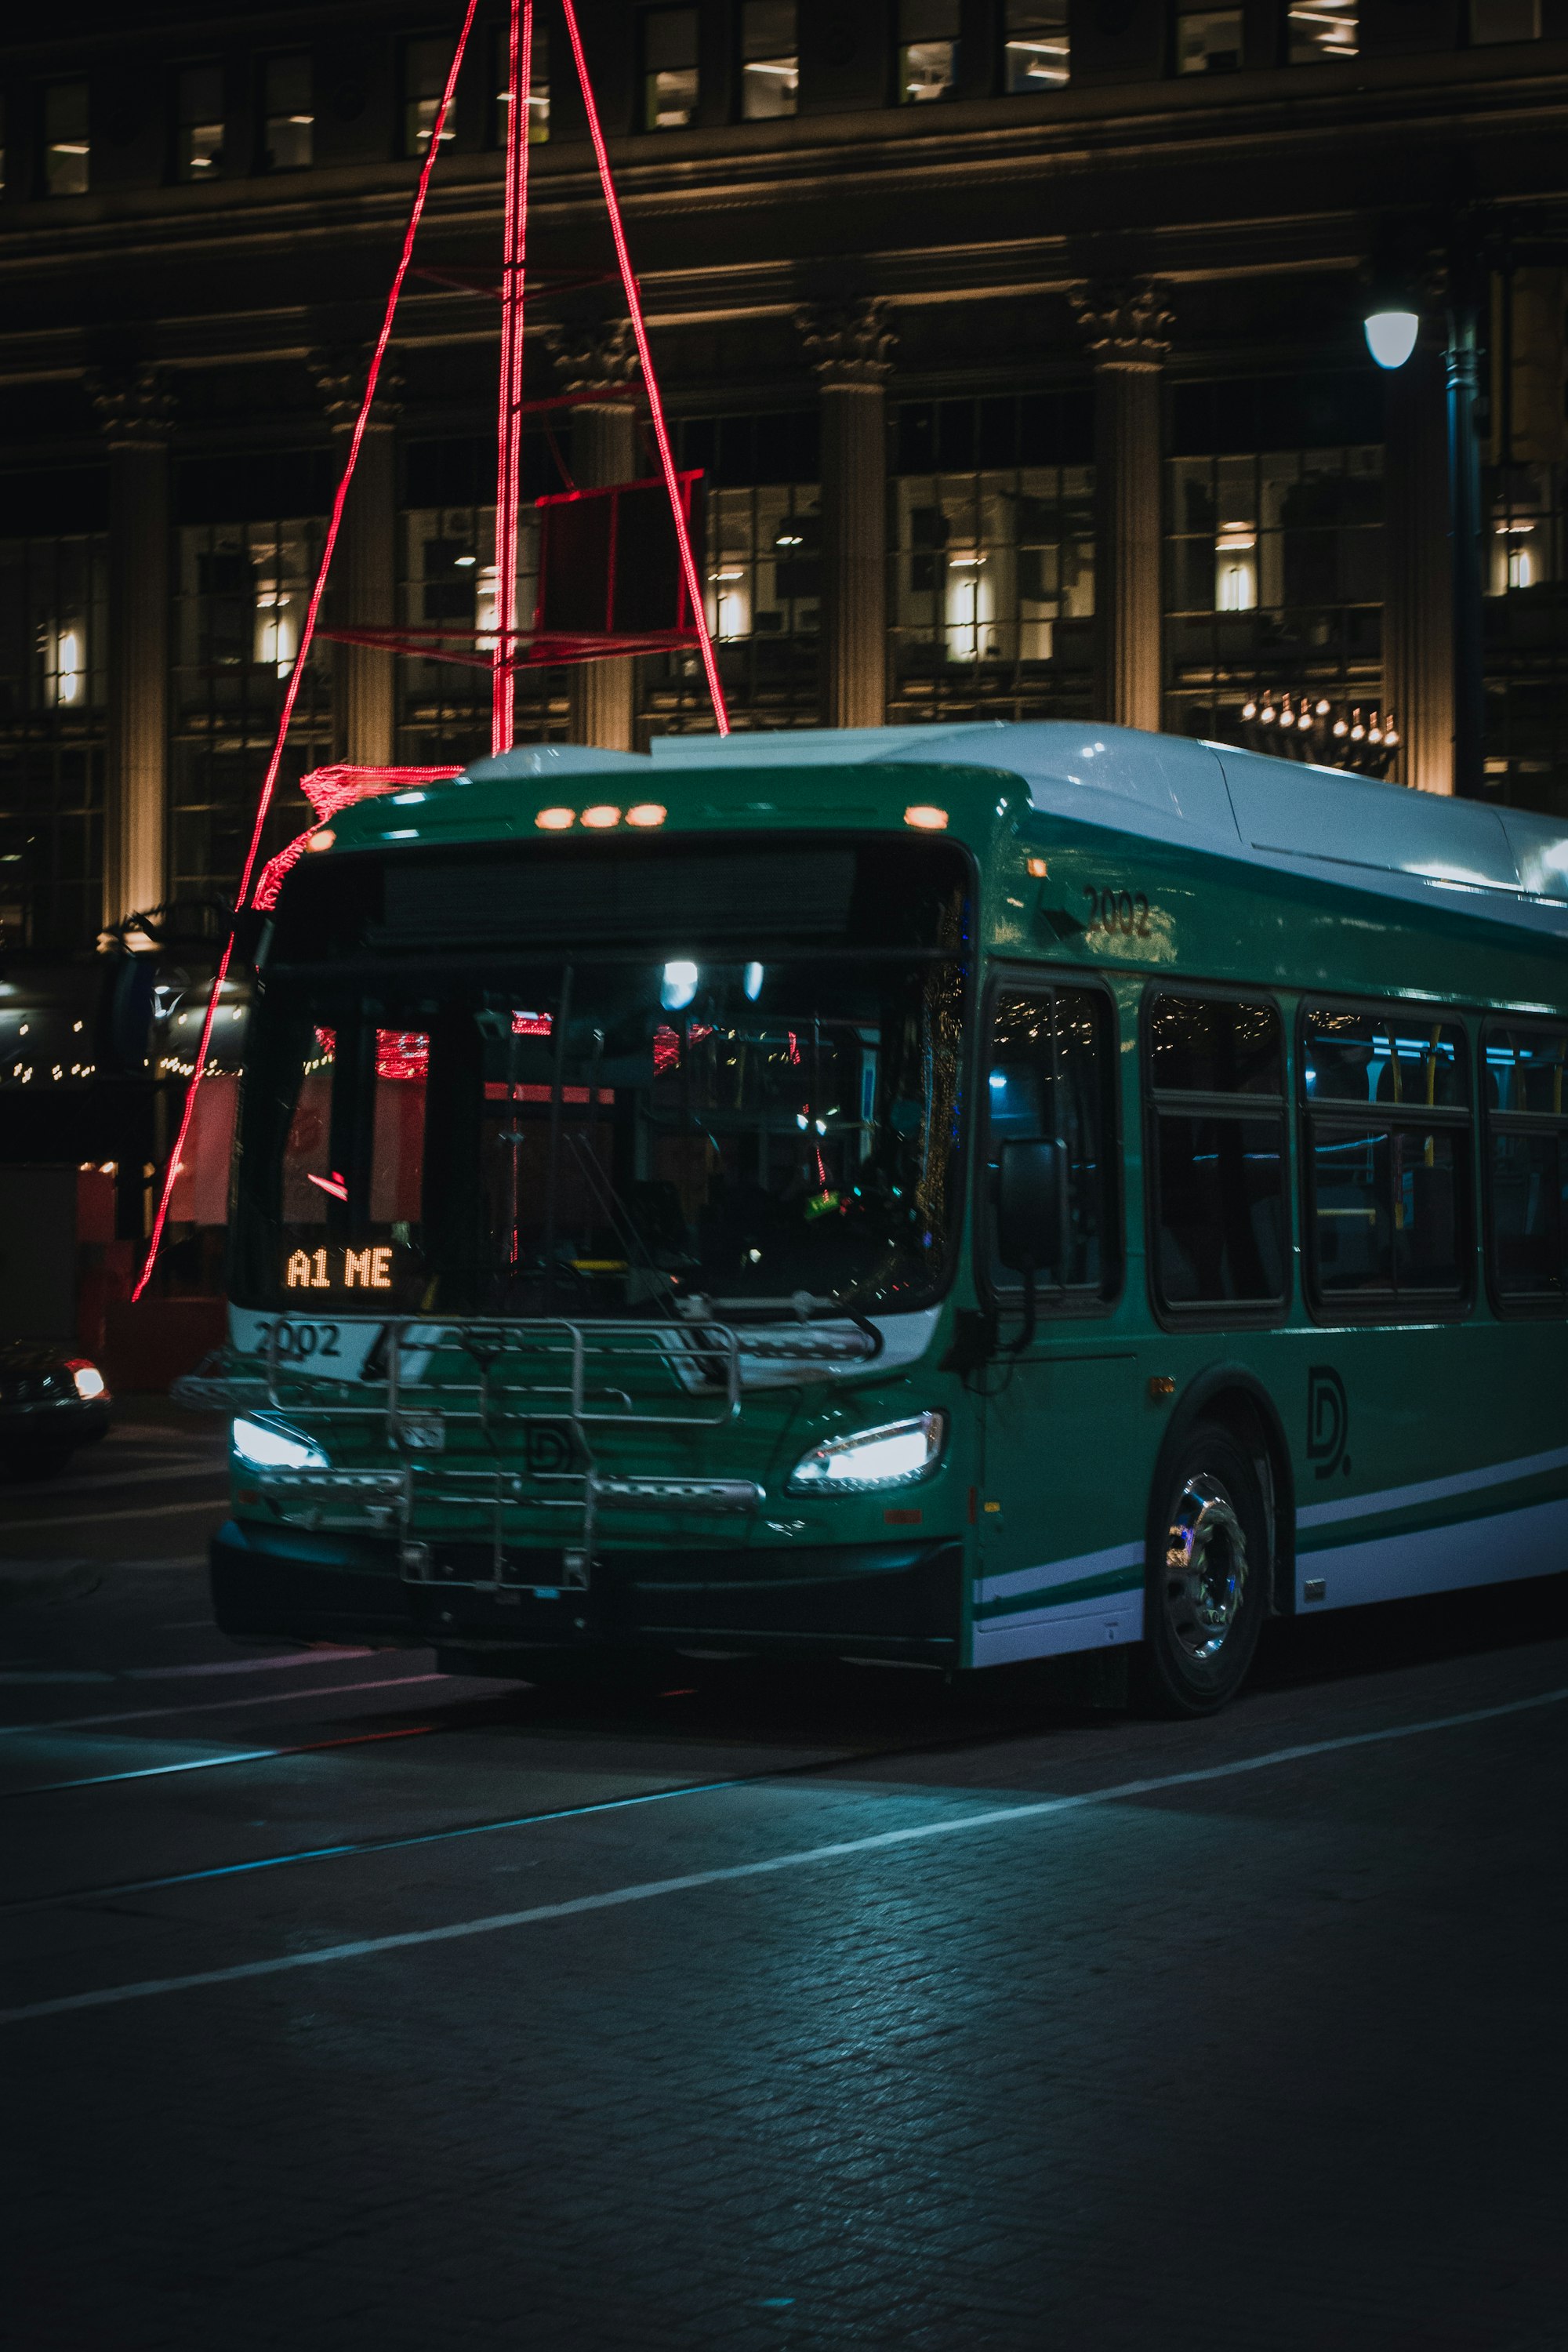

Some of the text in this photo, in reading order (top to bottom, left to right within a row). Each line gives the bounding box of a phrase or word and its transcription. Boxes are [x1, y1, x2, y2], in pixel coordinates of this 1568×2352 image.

[1083, 884, 1150, 937] 2002
[286, 1247, 393, 1287] A1 ME
[256, 1320, 340, 1356] 2002
